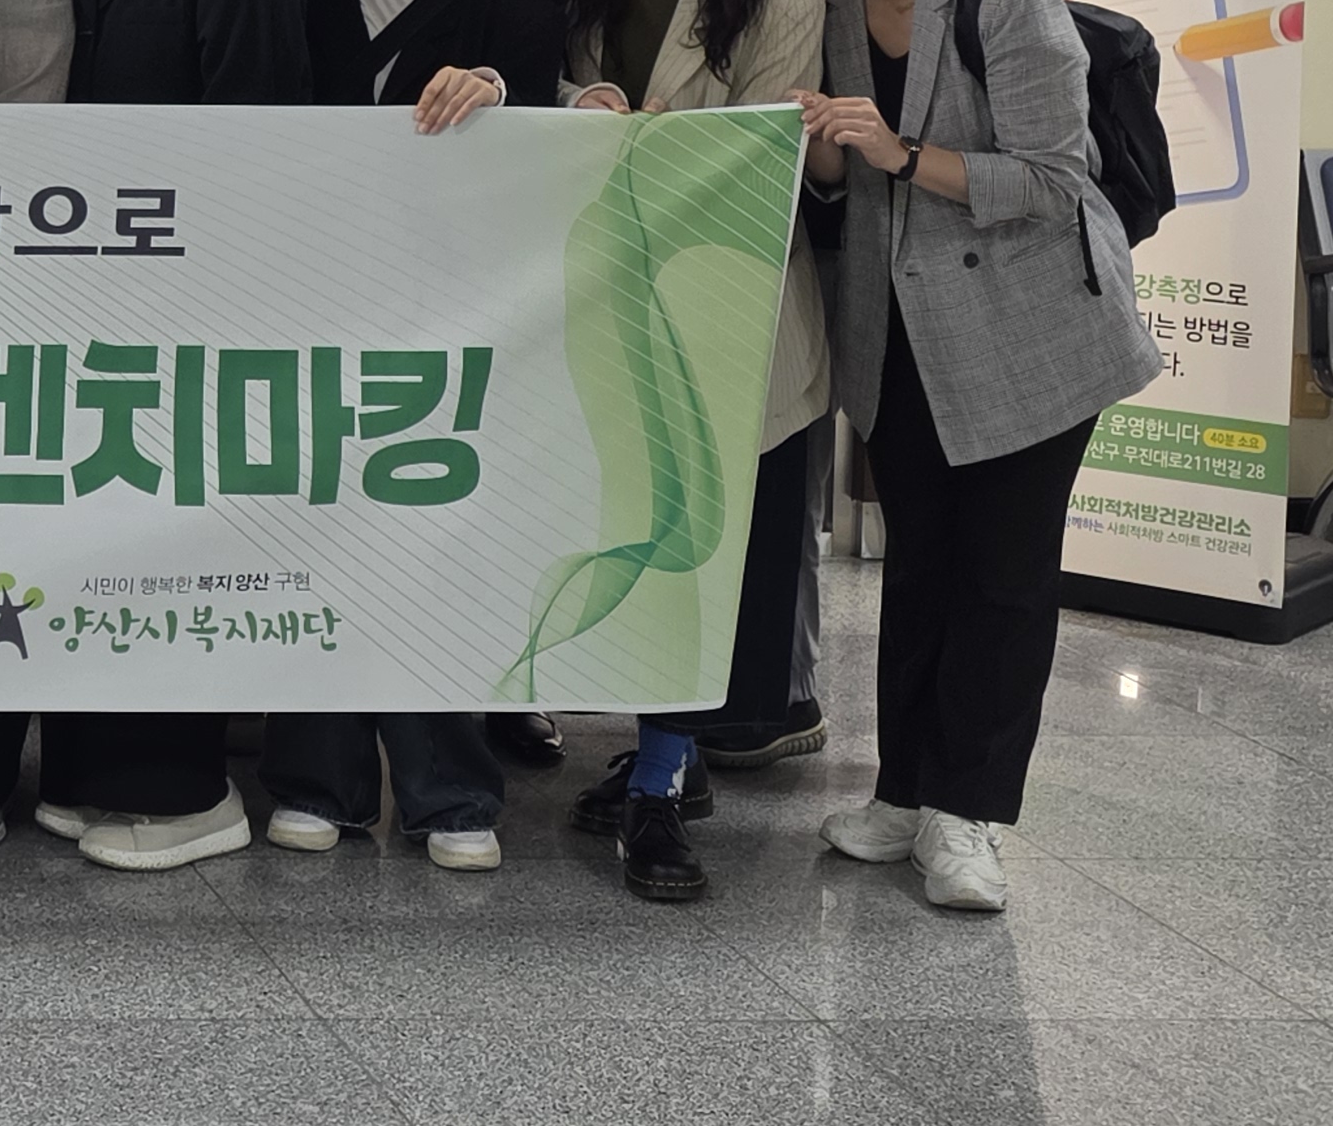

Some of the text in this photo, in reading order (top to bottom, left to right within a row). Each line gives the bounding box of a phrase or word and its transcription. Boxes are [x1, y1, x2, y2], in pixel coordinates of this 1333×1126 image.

[1184, 316, 1253, 349] 방법을
[1108, 413, 1201, 446] 운영합니다
[1237, 435, 1261, 450] 소요
[1084, 439, 1266, 480] 산구 무진대로211번길 28
[1106, 522, 1164, 543] 사회적처방
[1166, 531, 1202, 549] 스마트
[1204, 537, 1252, 557] 건강관리
[80, 576, 134, 596] 시민이
[140, 575, 193, 595] 행복한
[273, 572, 312, 592] 구현
